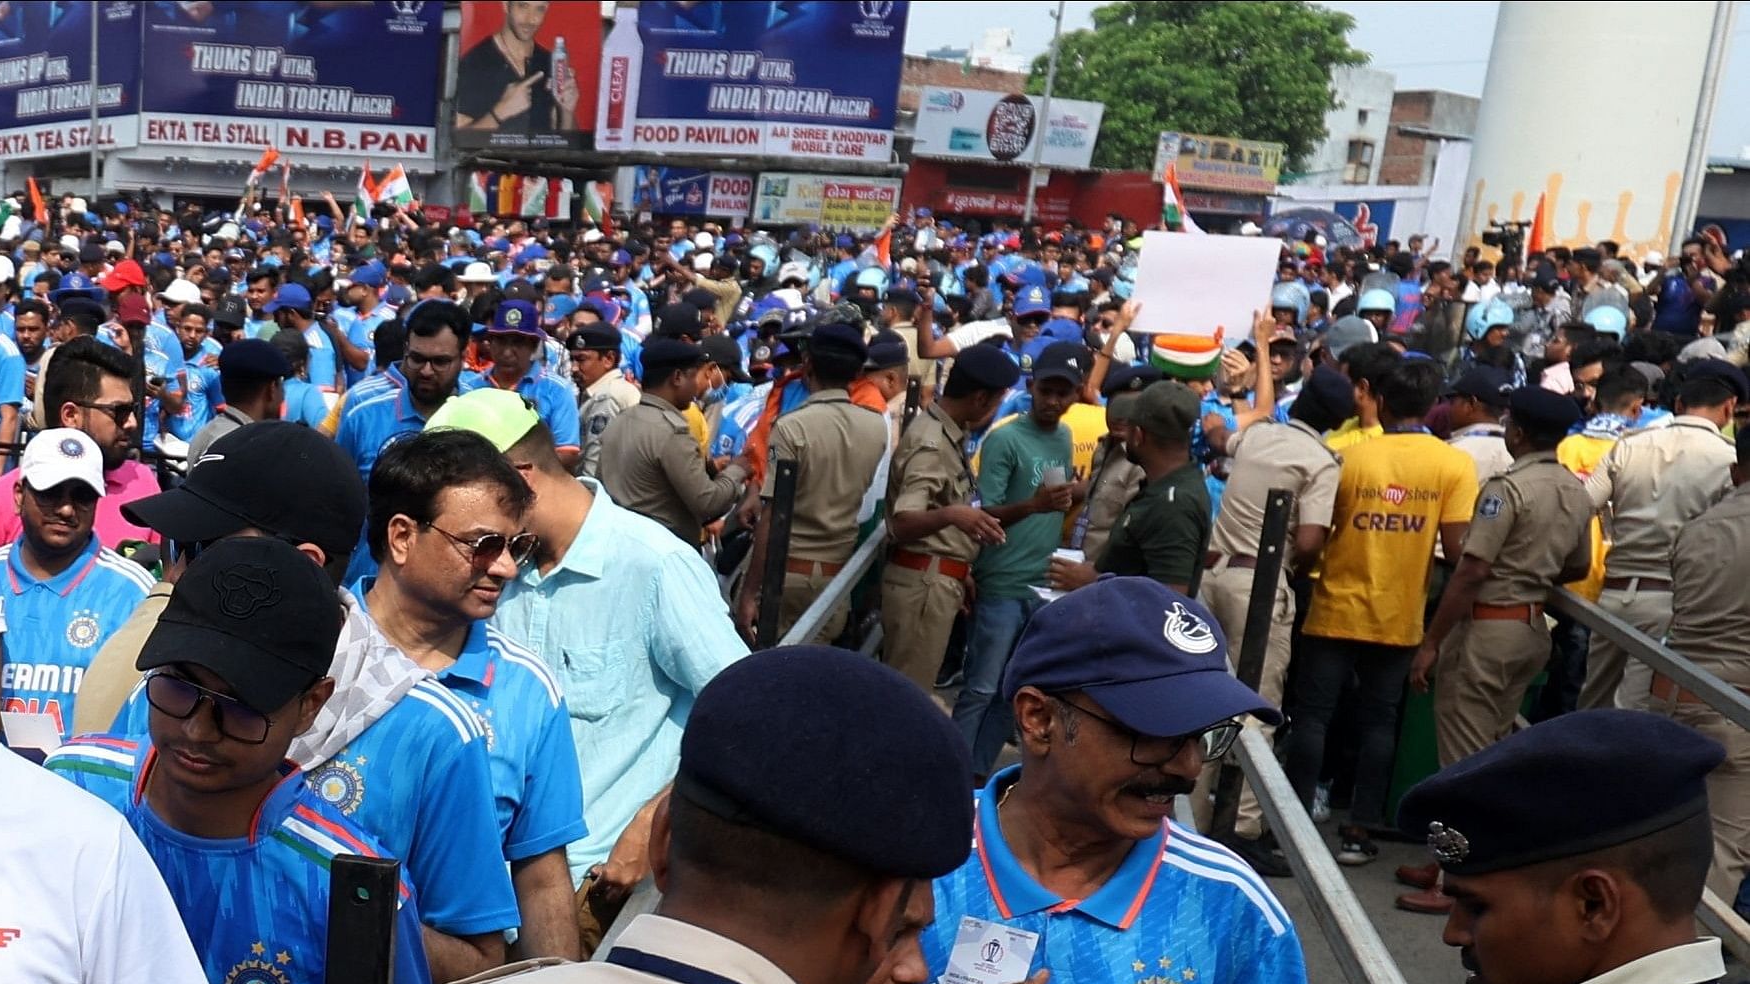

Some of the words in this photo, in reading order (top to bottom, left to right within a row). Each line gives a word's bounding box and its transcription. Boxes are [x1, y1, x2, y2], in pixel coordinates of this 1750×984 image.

[192, 45, 250, 72] THUMS
[254, 48, 279, 75] UP
[665, 51, 727, 77] THUMS
[730, 53, 756, 77] UP
[237, 83, 285, 109] INDIA
[289, 86, 351, 113] TOOFAN
[711, 86, 763, 110] INDIA
[765, 89, 829, 113] TOOFAN
[35, 132, 64, 149] TEA
[148, 120, 188, 141] EKTA
[192, 121, 220, 142] TEA
[227, 124, 271, 145] STALL
[634, 125, 679, 143] FOOD
[686, 127, 760, 144] PAVILION
[792, 128, 828, 140] SHREE
[833, 131, 887, 146] KHODIYAR
[791, 142, 832, 154] MOBILE
[836, 144, 865, 156] CARE
[712, 177, 750, 196] FOOD
[709, 198, 748, 211] PAVILION
[1353, 512, 1427, 533] CREW
[1, 663, 84, 694] EAM11
